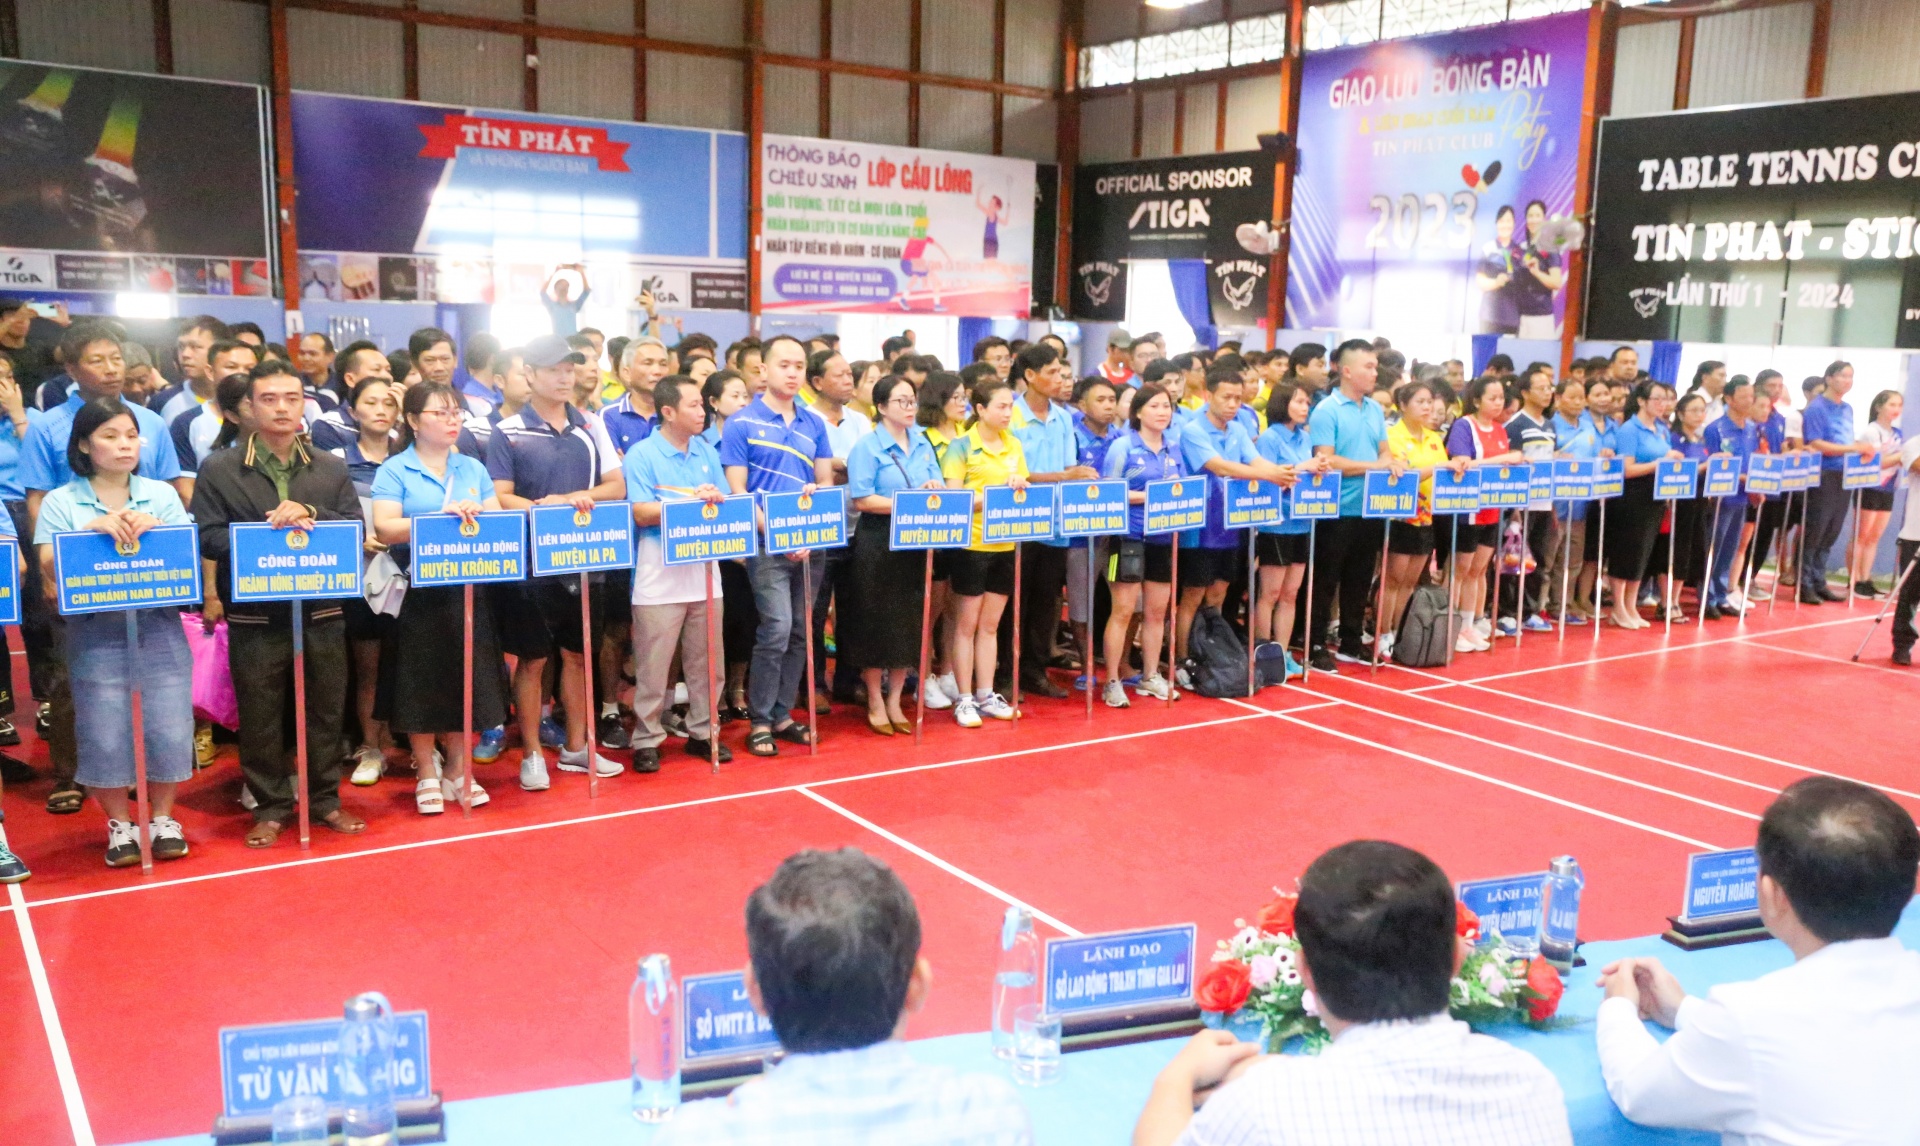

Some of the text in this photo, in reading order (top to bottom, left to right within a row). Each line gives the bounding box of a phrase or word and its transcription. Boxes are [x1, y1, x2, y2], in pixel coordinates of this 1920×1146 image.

[1329, 48, 1550, 109] GIAO BÓNG BÀN
[461, 121, 594, 153] TÍN PHÁT
[1451, 132, 1493, 150] CLUB
[767, 144, 861, 168] THÔNG BÁO
[867, 156, 973, 194] LỚP CẦU LÔNG
[1638, 144, 1879, 191] TABLE TENNIS
[768, 169, 857, 190] CHIÊU SINH
[1095, 166, 1252, 195] OFFICIAL SPONSOR
[1365, 190, 1478, 250] 2023
[1631, 223, 1696, 261] TIN
[1703, 220, 1812, 261] PHAT
[1819, 237, 1834, 250] -
[0, 271, 43, 283] TIGA
[1753, 282, 1763, 308] 1
[1797, 282, 1854, 309] 2024
[987, 505, 1051, 519] LIÊN ĐOÀN LAO ĐỘNG
[1063, 502, 1077, 514] LIÊN
[1094, 503, 1107, 513] LAO
[1178, 500, 1189, 509] LAO
[1369, 491, 1413, 514] TRỌNG TÀI
[668, 520, 752, 539] LIÊN ĐOÀN LAO ĐỘNG
[770, 511, 842, 529] LIÊN ĐOÀN LAO ĐỘNG
[896, 512, 968, 526] LIÊN ĐOÀN LAO ĐỘNG
[988, 521, 1011, 539] HUYỆN
[1033, 520, 1051, 534] YANG
[1065, 516, 1089, 532] HUYỆN
[538, 528, 627, 546] LIÊN ĐOÀN LAO ĐỘNG
[775, 525, 839, 549] THỊ XÃ AN KHÊ
[900, 527, 930, 546] HUYỆN
[950, 528, 963, 543] PƠ
[418, 540, 520, 556] LIÊN ĐOÀN LAO ĐỘNG
[551, 546, 617, 568] HUYỆN IA PA
[675, 537, 747, 559] HUYỆN KBANG
[94, 558, 164, 571] CÔNG ĐOÀN
[257, 552, 338, 569] CÔNG ĐOÀN
[420, 557, 519, 581] HUYỆN KRÔNG PA
[238, 570, 356, 594] NGÀNH NÔNG NGHIỆP & PTNT
[71, 585, 191, 605] CHI NHÁNH NAM GIA LAI
[1487, 887, 1520, 903] LÃNH
[1693, 878, 1756, 907] NGUYỄN HOÀNG
[1083, 944, 1125, 963] LÃNH
[1067, 975, 1085, 999] LAO
[1084, 969, 1108, 1002] ĐỘNG
[1171, 963, 1186, 985] LAI
[713, 1011, 745, 1038] VHTT
